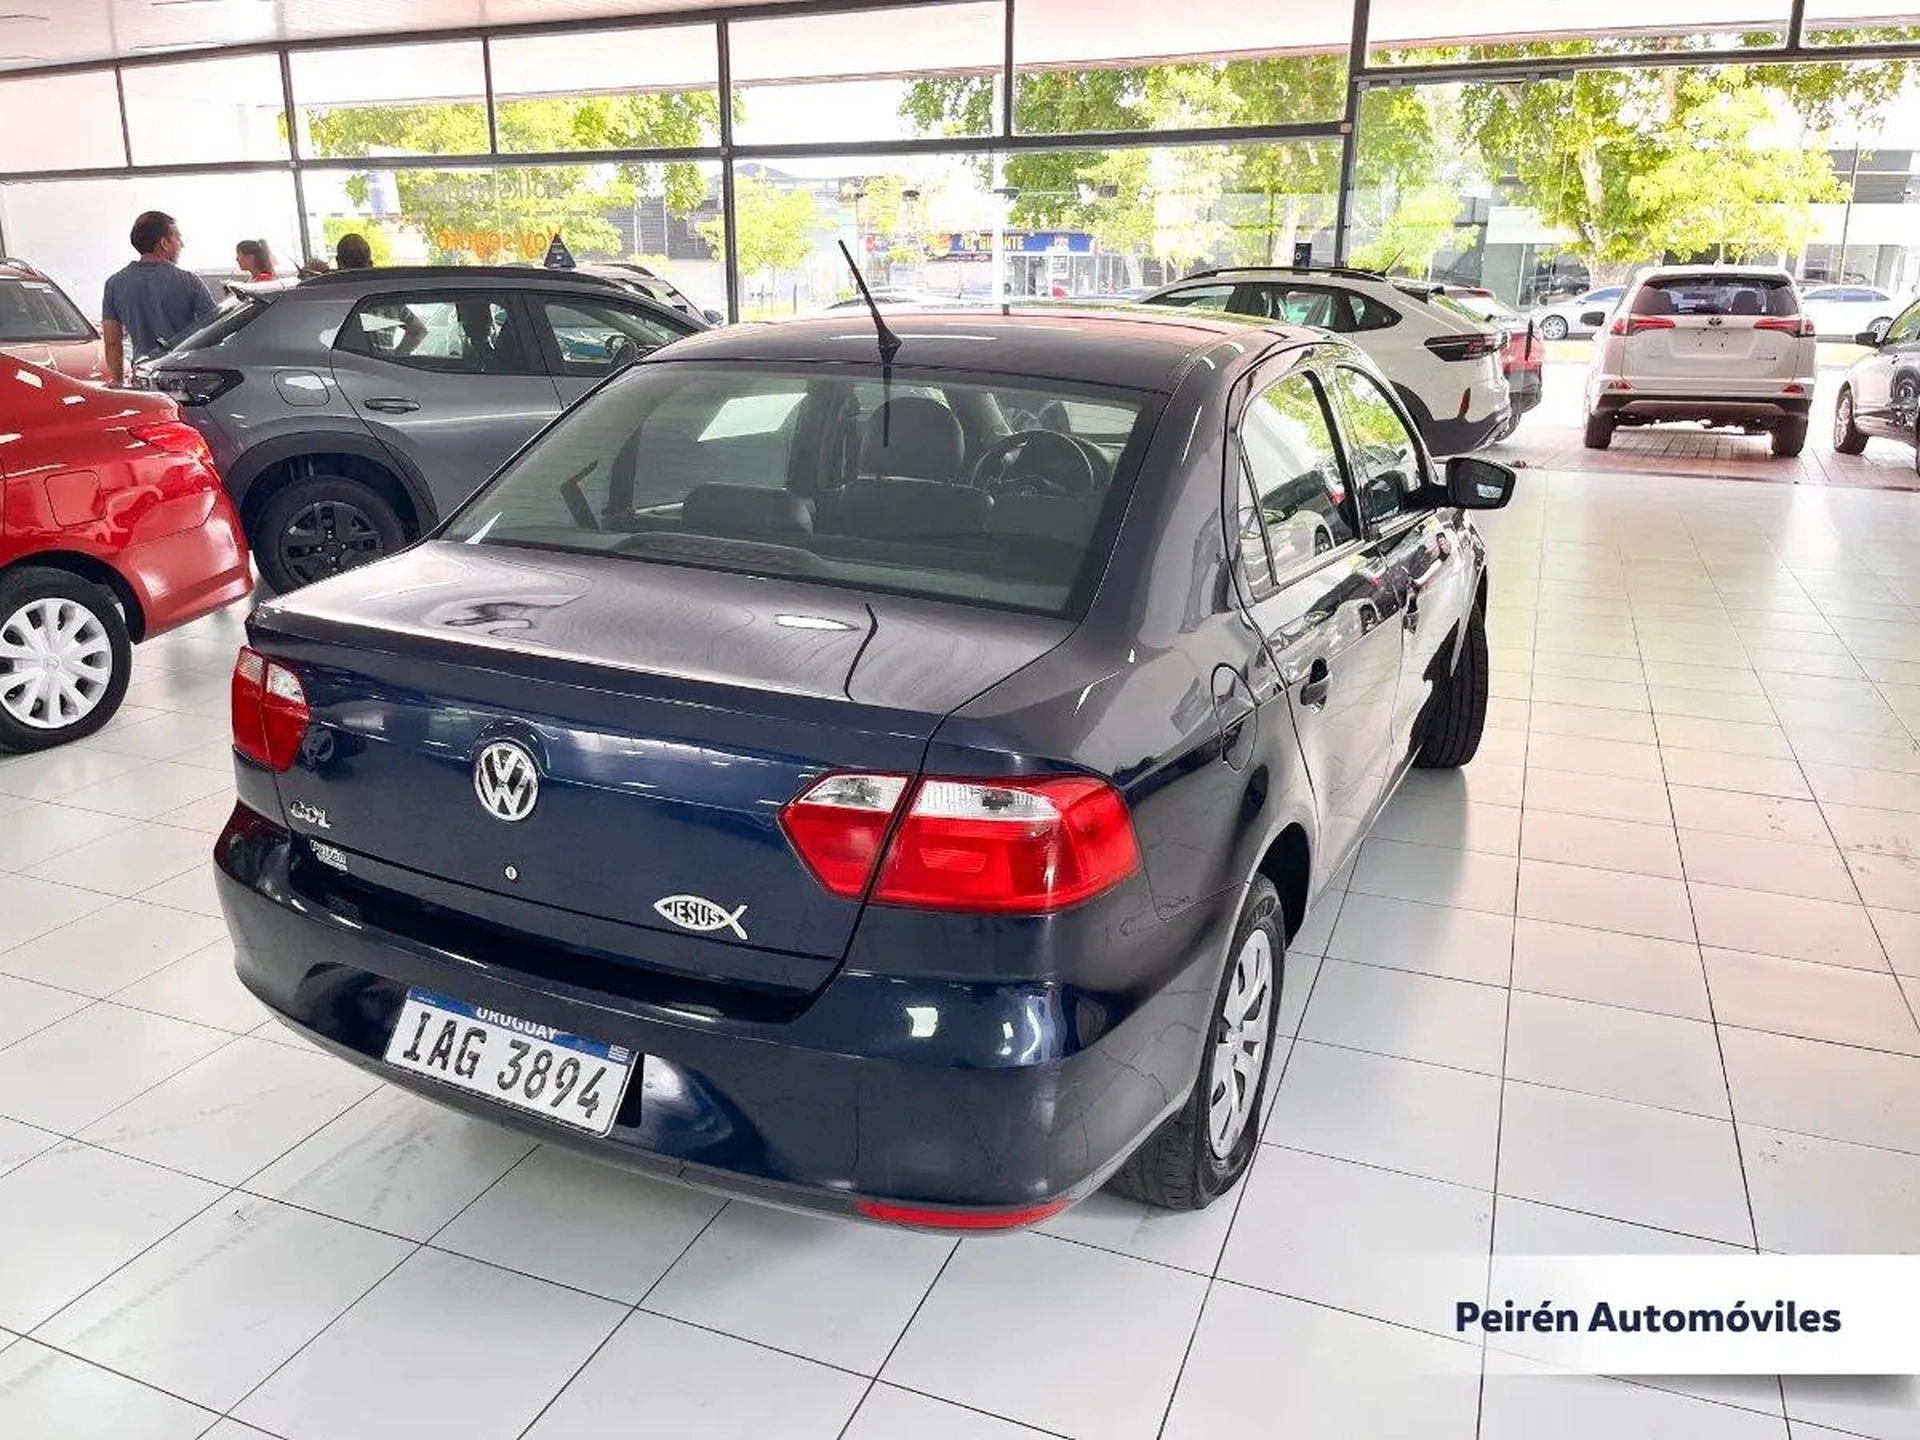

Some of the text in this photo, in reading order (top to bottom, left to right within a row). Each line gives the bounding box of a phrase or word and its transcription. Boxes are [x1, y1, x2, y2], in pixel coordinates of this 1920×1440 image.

[980, 234, 1024, 251] GINTE
[291, 800, 332, 829] GOL
[664, 900, 721, 926] JESUS
[476, 1006, 558, 1040] URUGUAY
[403, 1011, 607, 1119] IAG 3894
